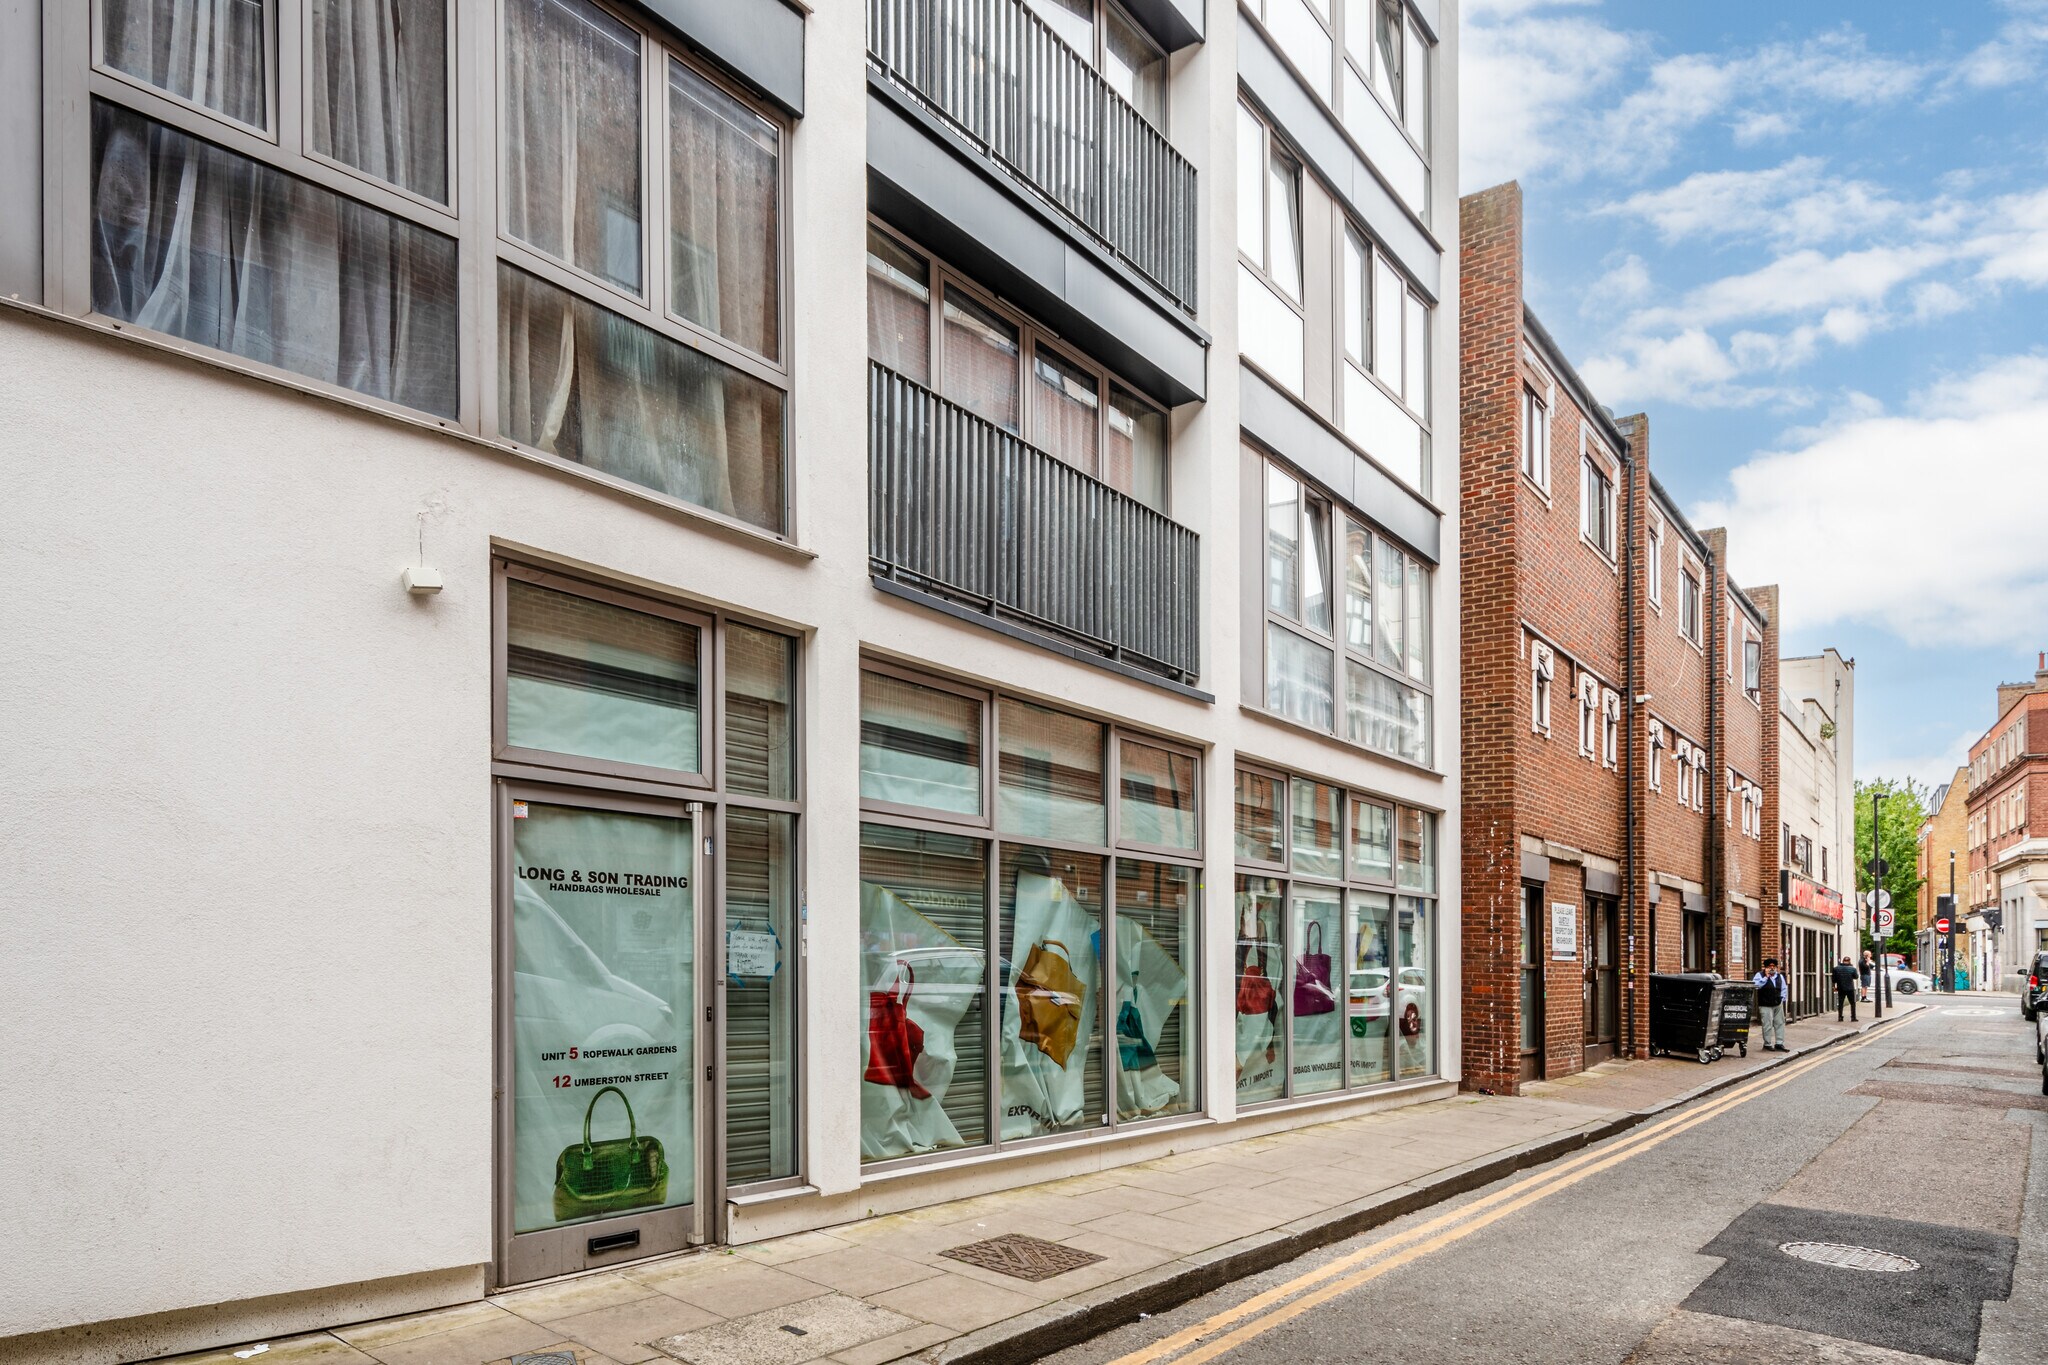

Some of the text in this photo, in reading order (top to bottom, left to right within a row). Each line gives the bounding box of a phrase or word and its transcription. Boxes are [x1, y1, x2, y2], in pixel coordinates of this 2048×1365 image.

[518, 866, 688, 888] LONG & SON TRADING
[549, 883, 661, 896] HANDBAGS WHOLESALE
[541, 1045, 677, 1061] UNIT 5 ROPEWALK GARDENS
[1311, 1061, 1341, 1072] WHOLESALE
[552, 1072, 669, 1088] 12 UMBERSTON STREET
[1253, 1069, 1273, 1083] IMPORT
